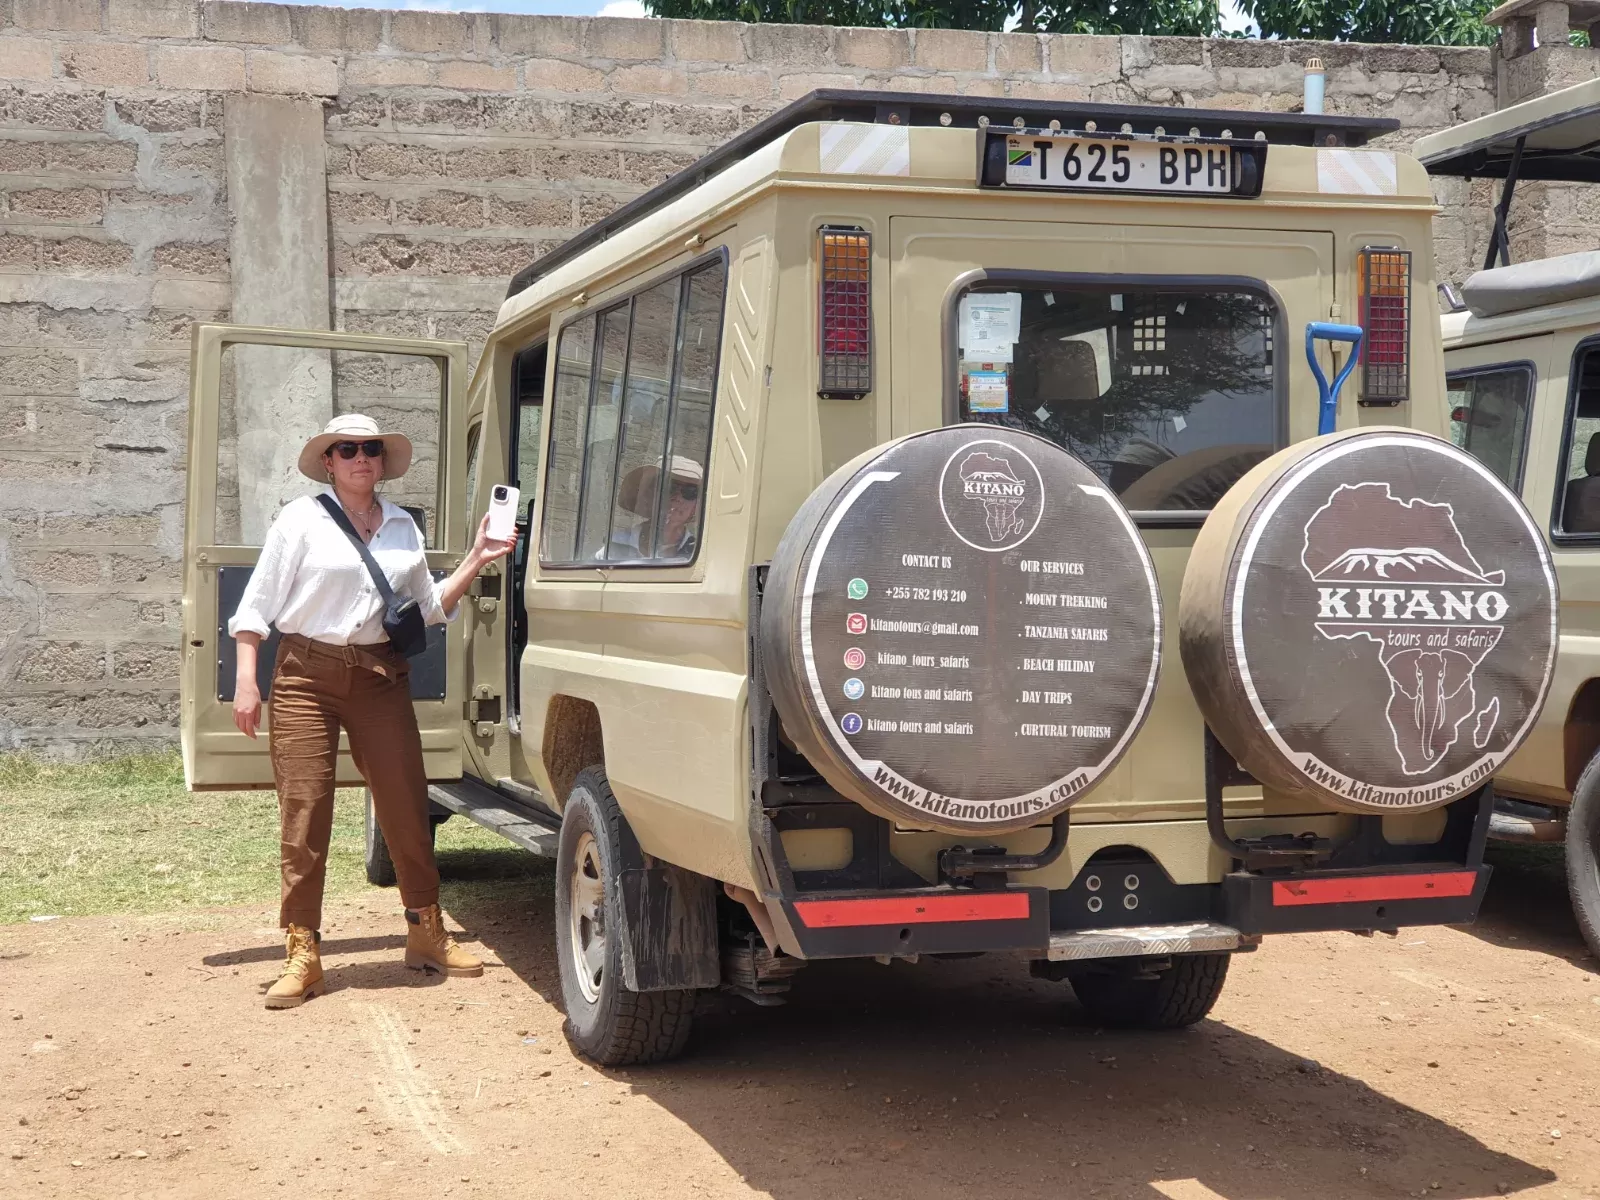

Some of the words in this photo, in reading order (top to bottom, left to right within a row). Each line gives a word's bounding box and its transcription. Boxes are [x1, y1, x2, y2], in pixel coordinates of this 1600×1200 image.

[1033, 141, 1053, 180] T
[1063, 142, 1130, 183] 625
[1160, 147, 1226, 188] BPH
[964, 482, 1024, 496] KITANO
[902, 554, 939, 568] CONTACT
[942, 556, 951, 569] US
[1021, 560, 1040, 572] OUR
[1042, 561, 1084, 575] SERVICES
[885, 586, 910, 600] +255
[913, 587, 930, 601] 782
[932, 588, 948, 602] 193
[951, 589, 967, 603] 210
[1025, 593, 1057, 606] MOUNT
[1060, 595, 1108, 609] TREKKING
[1317, 587, 1510, 622] KITANO
[870, 618, 979, 636] kitanotours@gmail.com
[1025, 625, 1068, 639] TANZANIA
[1071, 628, 1108, 641] SAFARIS
[1388, 629, 1421, 647] tours
[1427, 627, 1450, 647] and
[1455, 629, 1495, 648] safaris
[1023, 658, 1054, 671] BEACH
[871, 685, 901, 699] kitano
[903, 687, 922, 700] tous
[924, 688, 941, 701] and
[943, 689, 973, 702] safaris
[1022, 690, 1041, 703] DAY
[1044, 691, 1072, 705] TRIPS
[867, 718, 897, 732] kitano
[900, 719, 922, 733] tours
[925, 721, 941, 734] and
[944, 722, 974, 735] safaris
[1071, 725, 1111, 738] TOURISM
[1303, 758, 1495, 806] www.kitanotours.com
[873, 766, 1089, 820] www.kitanotours.com
